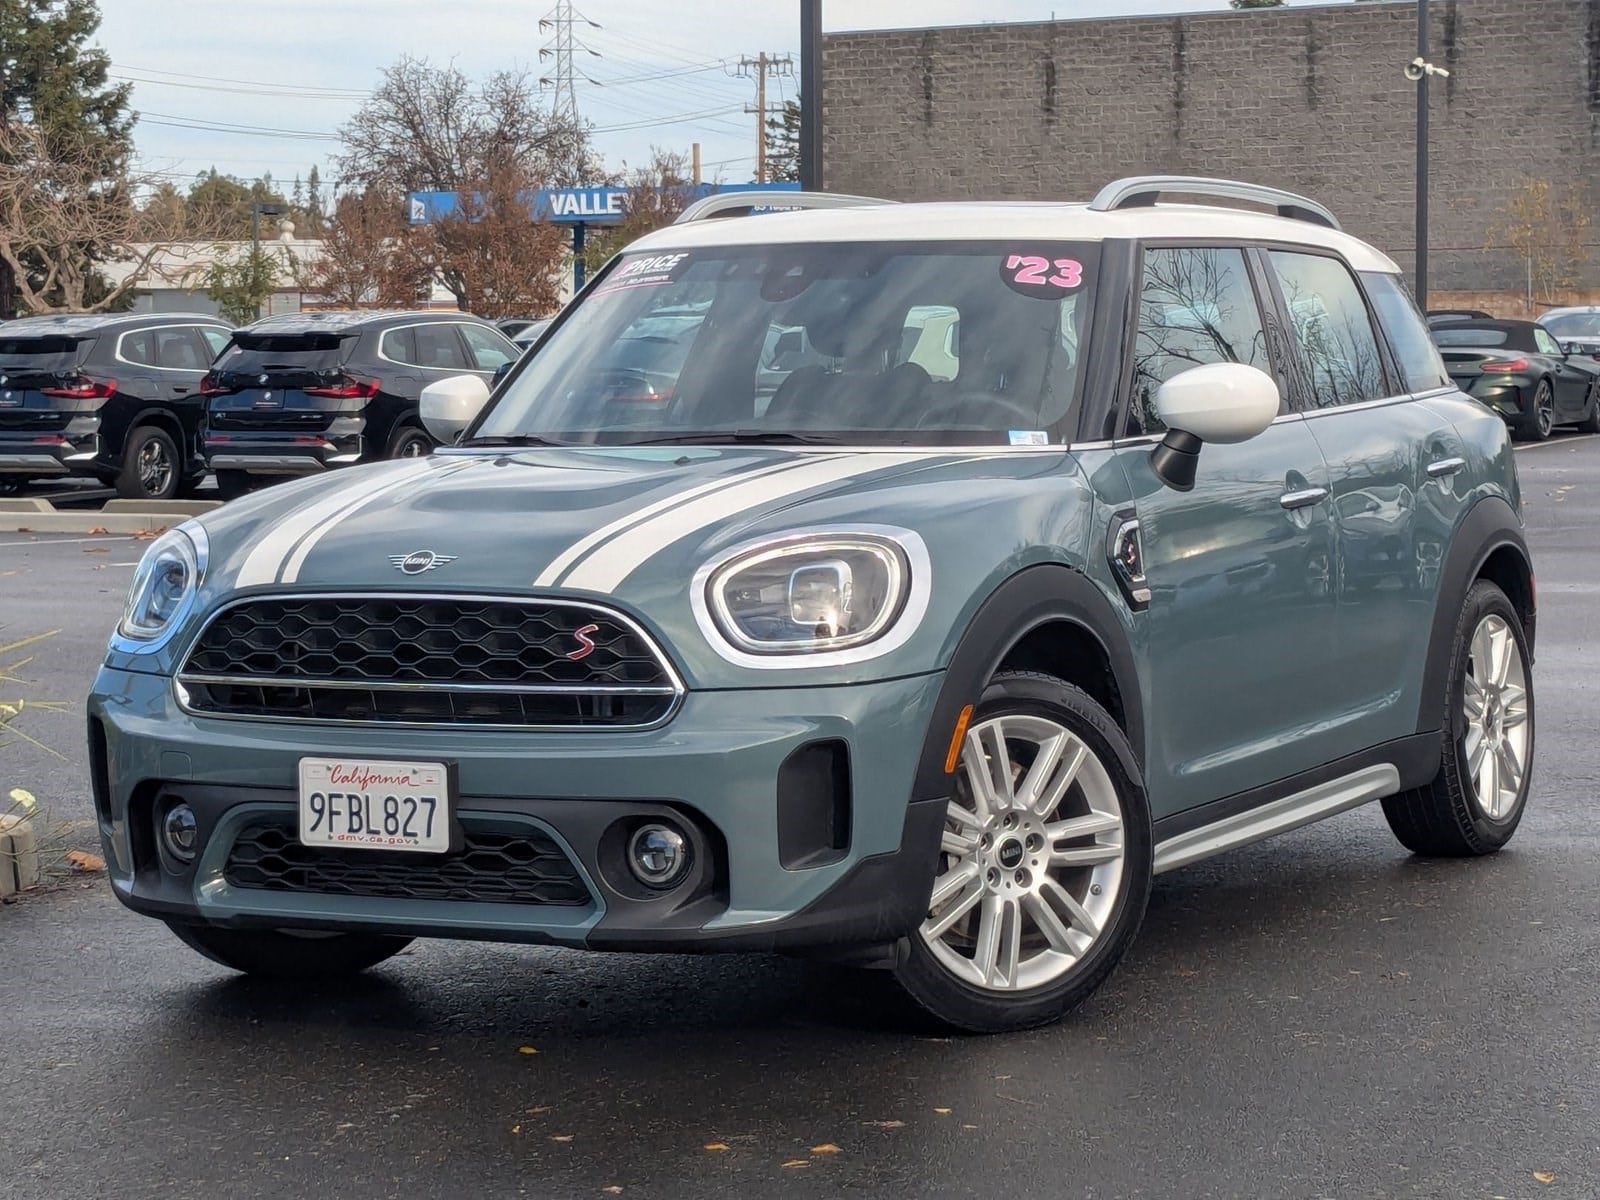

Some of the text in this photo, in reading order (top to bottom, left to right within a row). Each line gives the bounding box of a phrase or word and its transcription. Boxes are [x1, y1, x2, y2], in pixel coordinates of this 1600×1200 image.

[626, 253, 689, 274] PRICE
[1006, 255, 1083, 288] '23
[566, 624, 599, 661] S
[330, 764, 420, 791] California
[309, 792, 437, 838] 9FBL827
[337, 833, 413, 846] dmv.ca.gov
